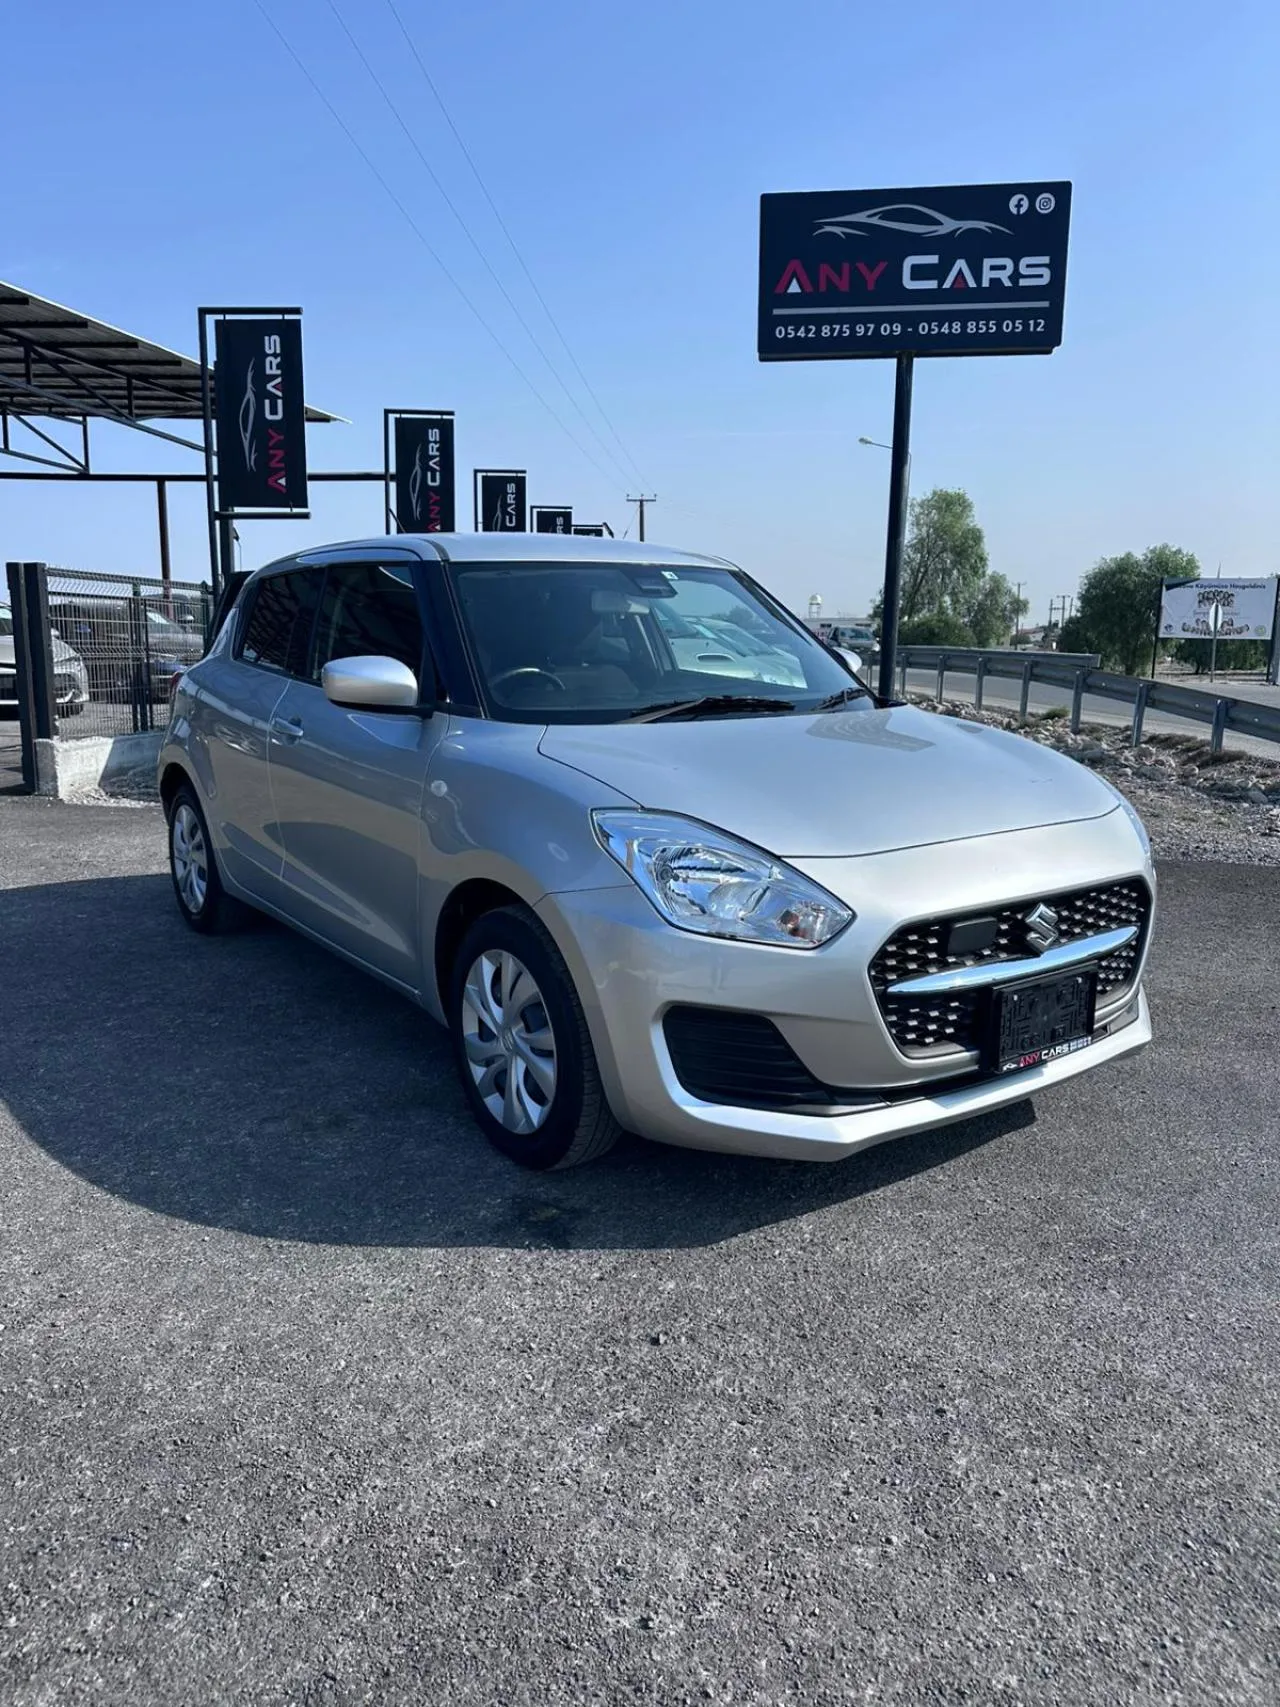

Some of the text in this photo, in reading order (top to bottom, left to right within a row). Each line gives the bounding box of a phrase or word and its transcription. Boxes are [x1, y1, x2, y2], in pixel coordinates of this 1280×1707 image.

[774, 254, 1051, 294] ANY CARS
[775, 325, 817, 339] 0542
[821, 324, 850, 338] 875
[855, 323, 875, 337] 97
[880, 322, 902, 336] 09
[918, 321, 961, 335] 0548
[967, 320, 997, 334] 855
[1002, 319, 1023, 333] 05
[1027, 318, 1045, 332] 12
[264, 334, 287, 493] ANY CARS
[427, 428, 441, 533] ANY CARS
[505, 482, 516, 527] CARS
[1019, 1044, 1069, 1067] ANY CARS
